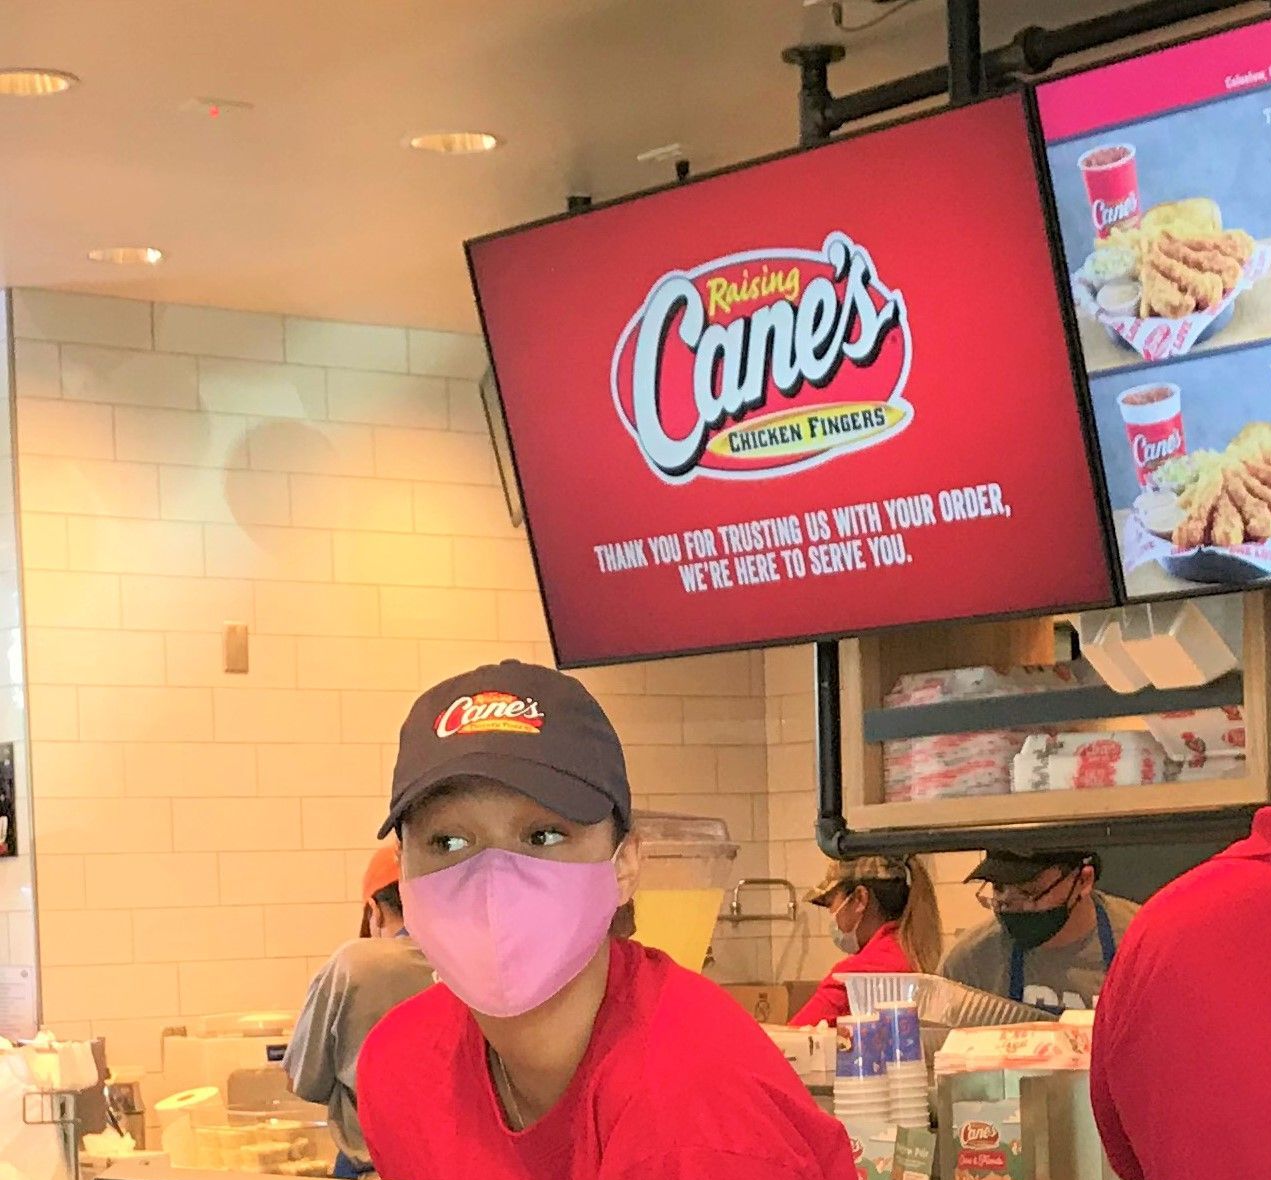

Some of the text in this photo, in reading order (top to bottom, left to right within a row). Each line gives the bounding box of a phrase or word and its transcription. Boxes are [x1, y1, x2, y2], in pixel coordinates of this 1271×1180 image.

[705, 263, 801, 316] Raising
[632, 238, 902, 476] Cane's
[727, 405, 887, 455] CHICKEN FINGERS
[594, 483, 1010, 573] THANK YOU FOR TRUSTING US WITH YOUR ORDER,
[679, 534, 913, 593] WE'RE HERE TO SERVE YOU.
[436, 696, 544, 738] Cane's
